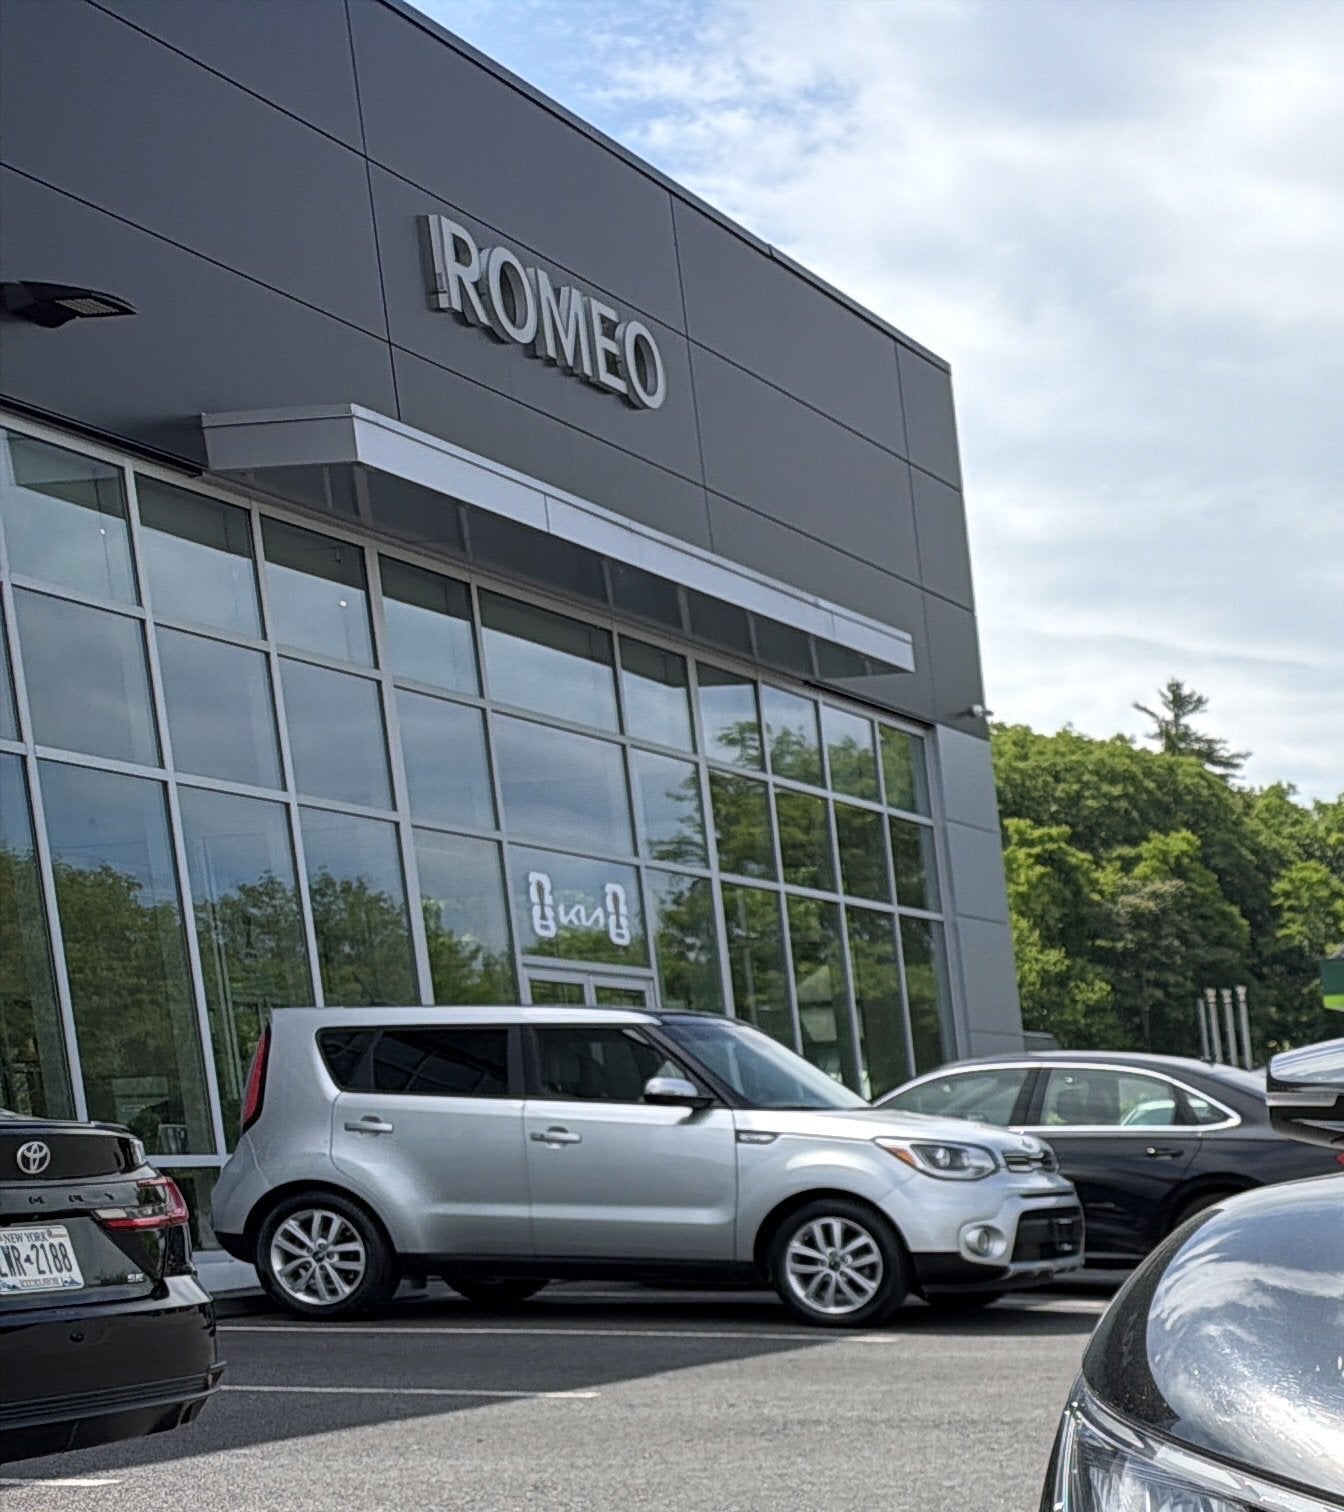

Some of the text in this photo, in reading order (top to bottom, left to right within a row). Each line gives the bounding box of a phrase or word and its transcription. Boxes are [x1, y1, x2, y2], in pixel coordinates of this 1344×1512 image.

[427, 213, 667, 409] ROMEO
[3, 1231, 50, 1244] NEW YORK
